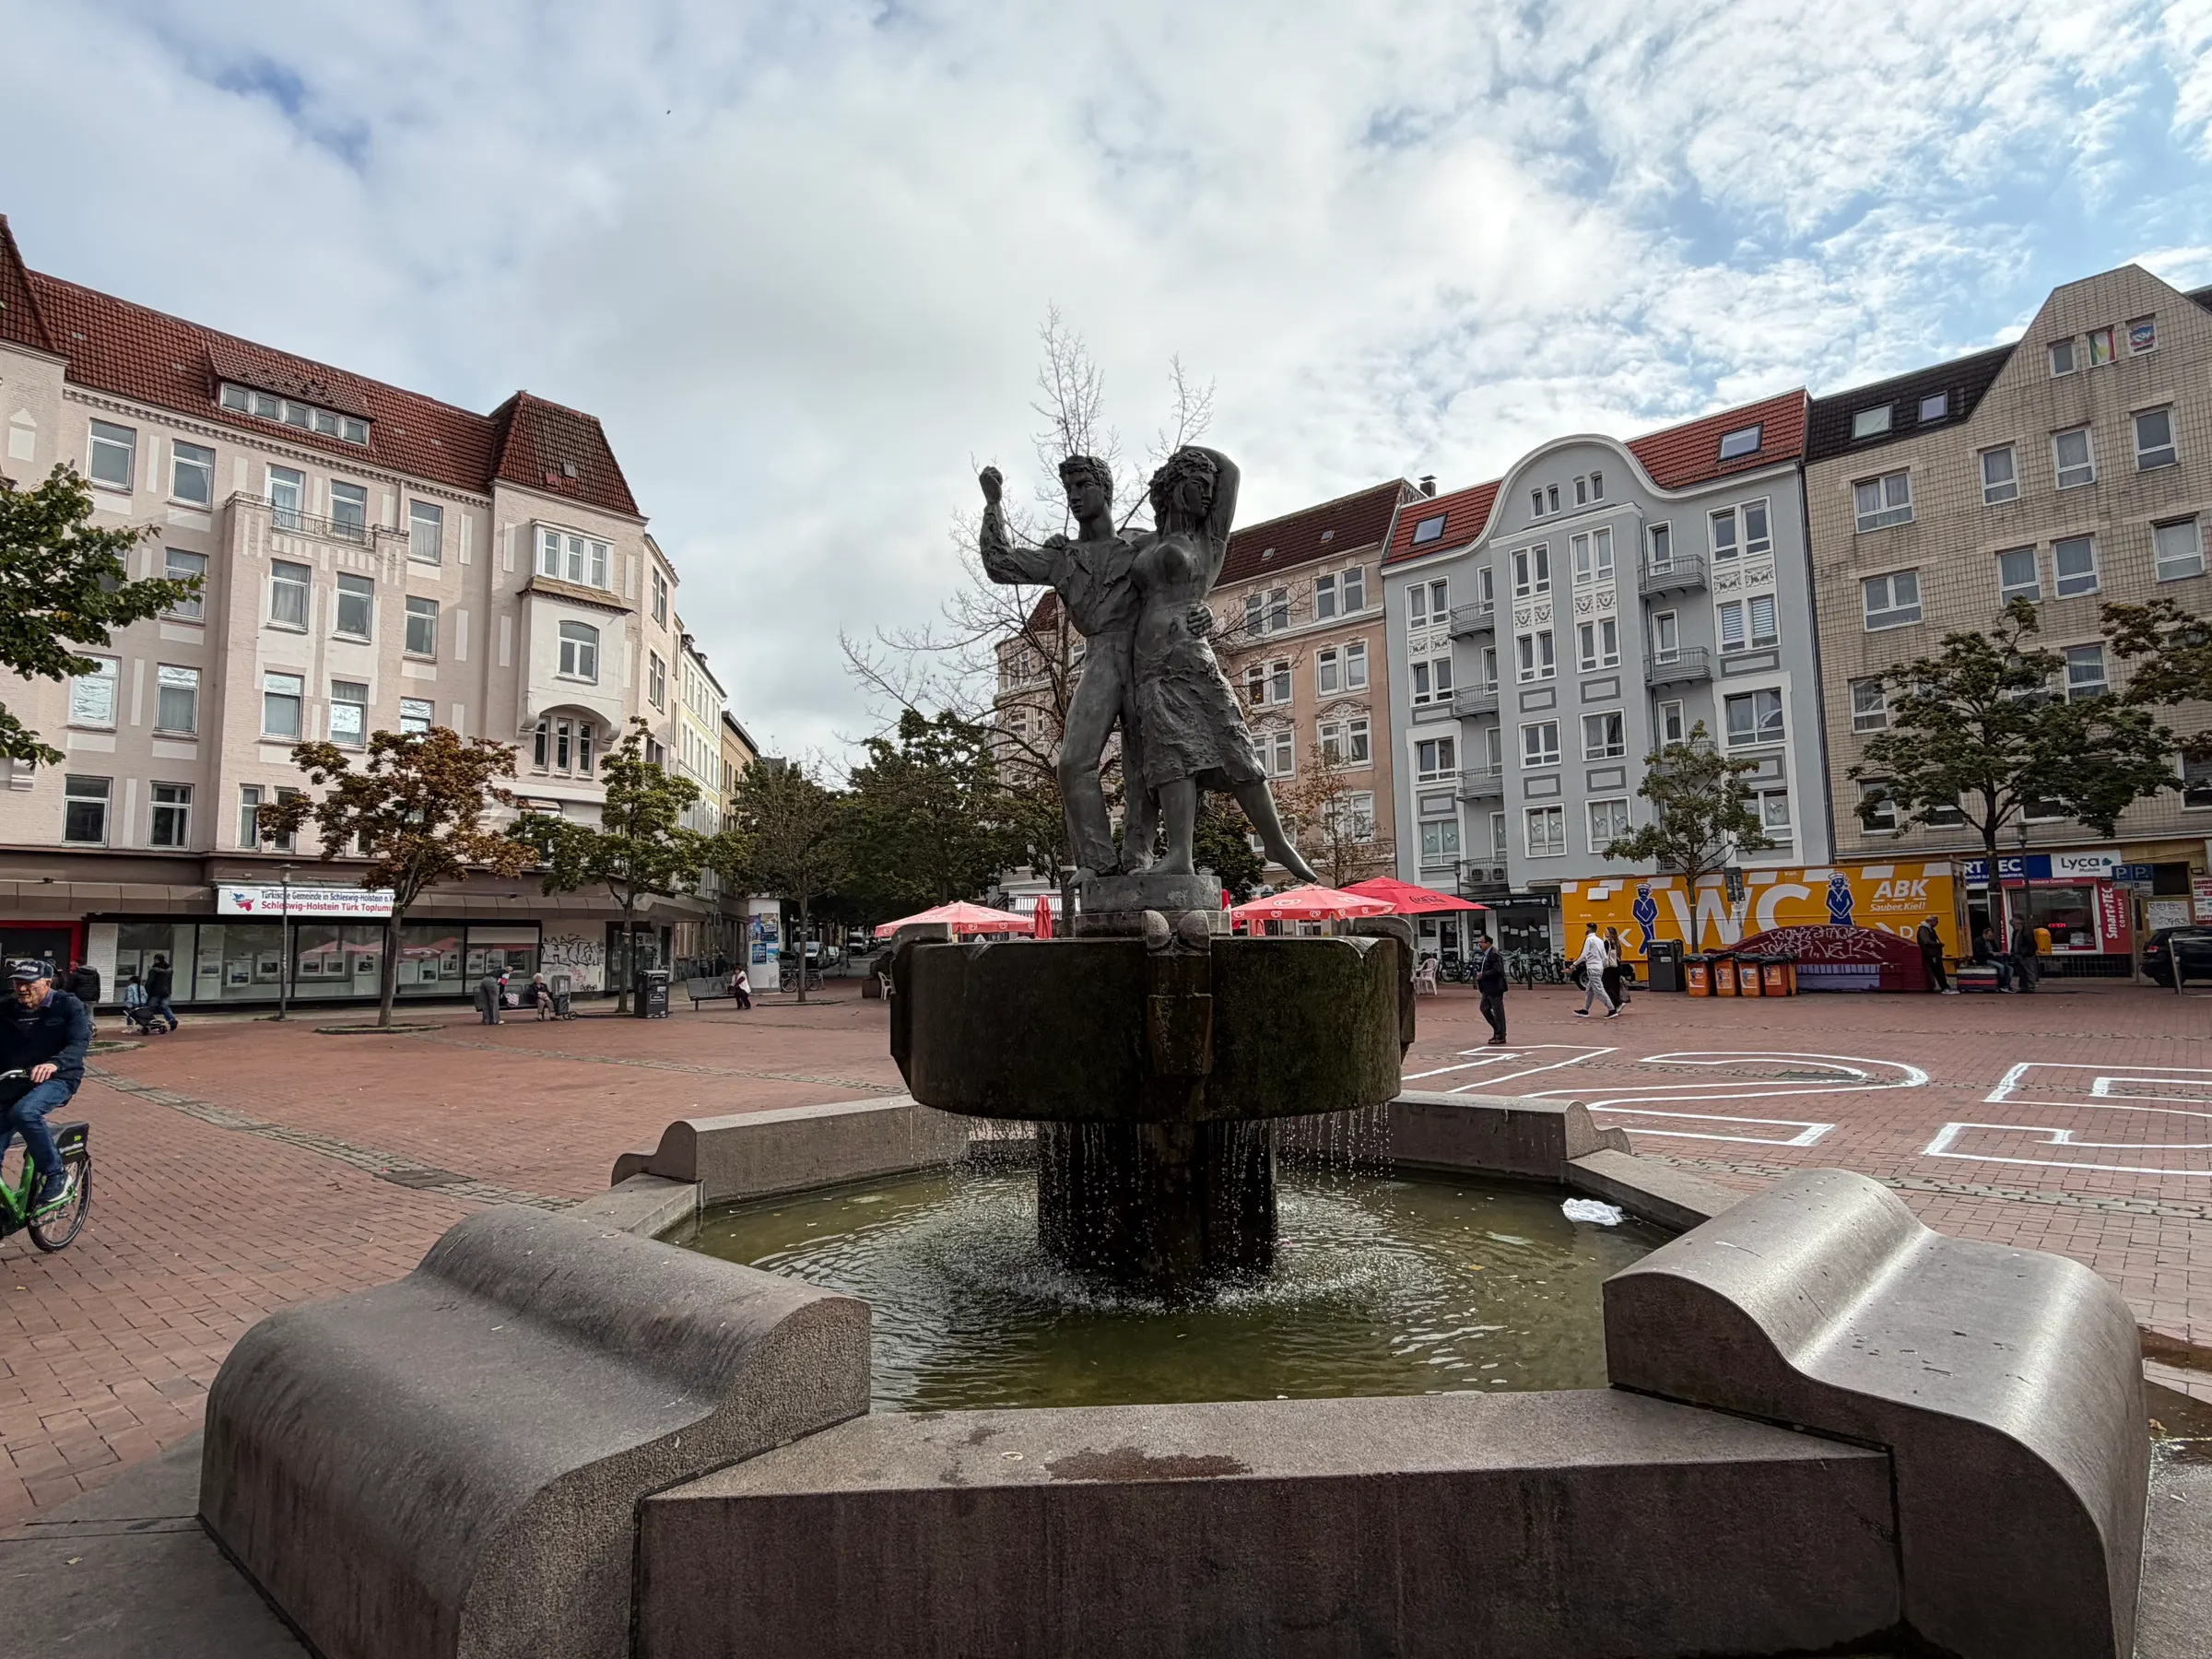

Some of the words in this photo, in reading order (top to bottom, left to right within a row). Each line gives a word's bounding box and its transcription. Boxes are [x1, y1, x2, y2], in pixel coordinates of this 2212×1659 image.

[1998, 858, 2022, 872] EC
[2061, 857, 2100, 870] Lyca
[2115, 866, 2127, 879] P
[2135, 866, 2147, 878] P
[1873, 878, 1930, 899] ABK
[261, 890, 291, 900] Türkisce
[292, 891, 322, 900] Gemeinde
[330, 892, 383, 902] Schleswig-Holstein
[342, 902, 359, 912] Türk
[1870, 903, 1902, 912] Sauber,
[1903, 901, 1926, 911] Kiel!
[2117, 898, 2125, 928] COMPANY
[1666, 883, 1811, 945] WC
